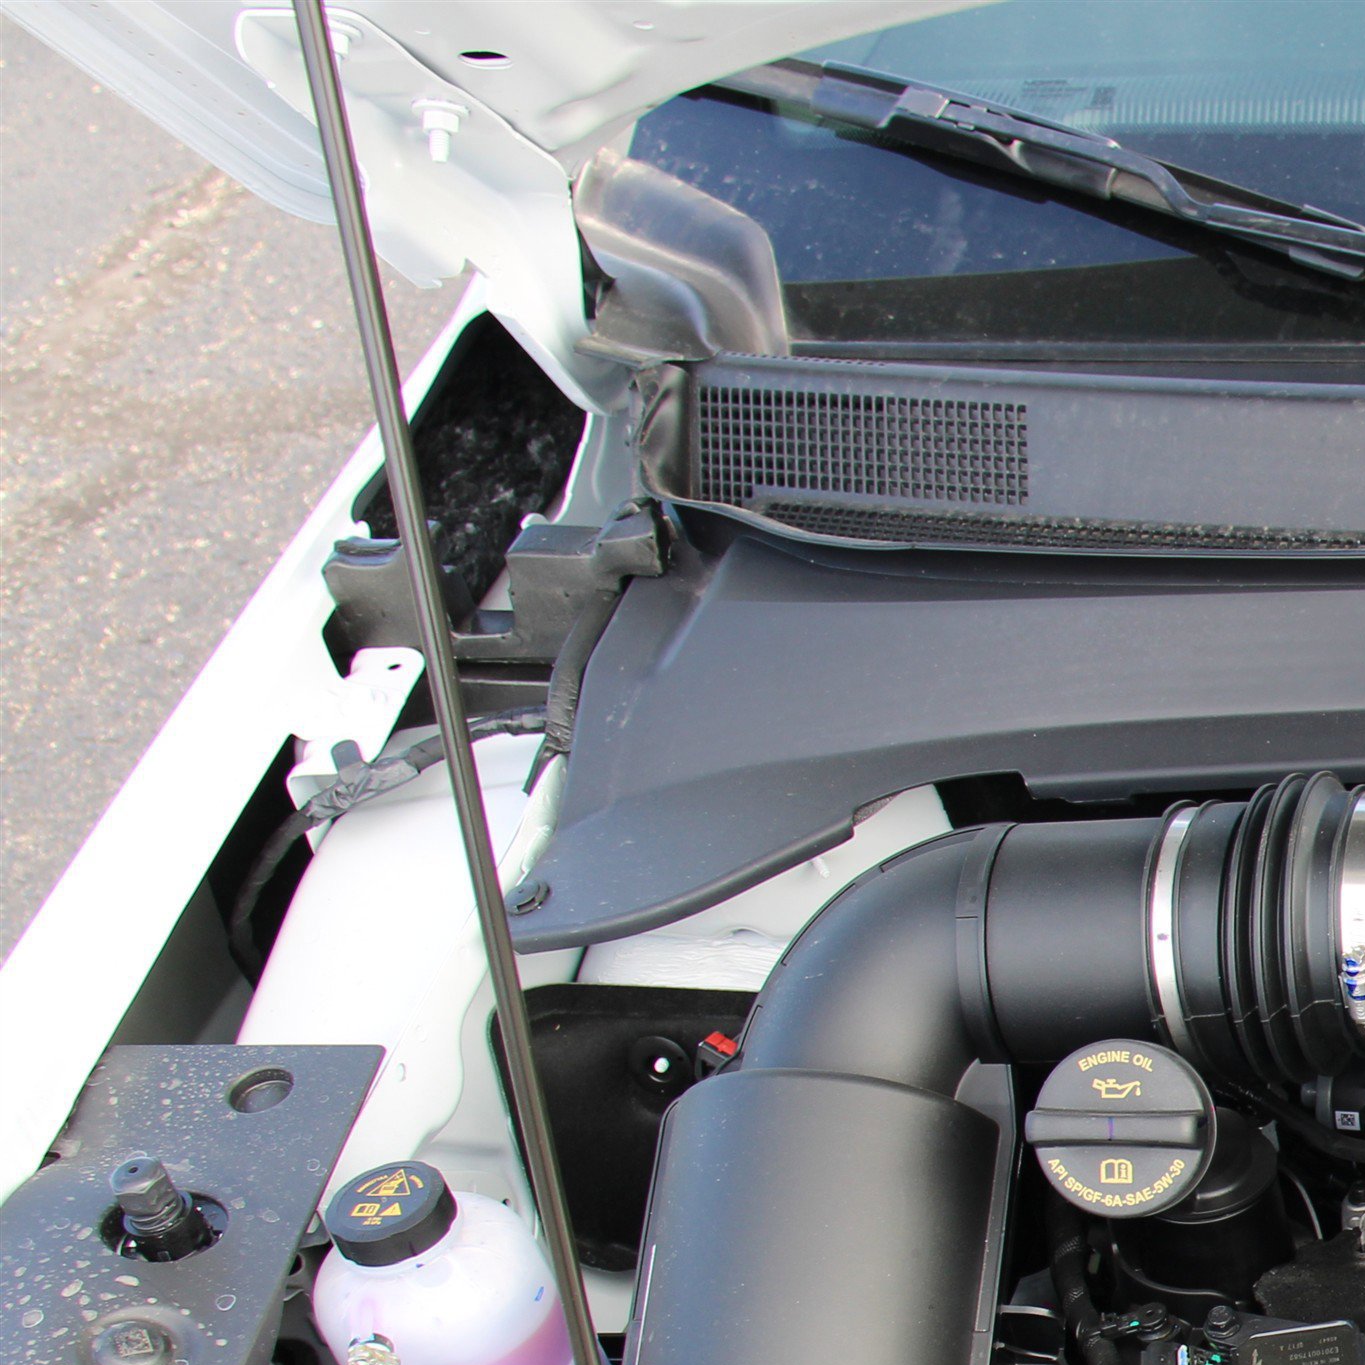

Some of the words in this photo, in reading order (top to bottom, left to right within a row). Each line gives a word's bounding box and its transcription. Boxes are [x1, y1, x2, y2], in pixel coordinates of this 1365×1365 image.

[1077, 1050, 1130, 1072] ENGINE
[1132, 1052, 1155, 1072] OIL
[1048, 1157, 1068, 1181] API
